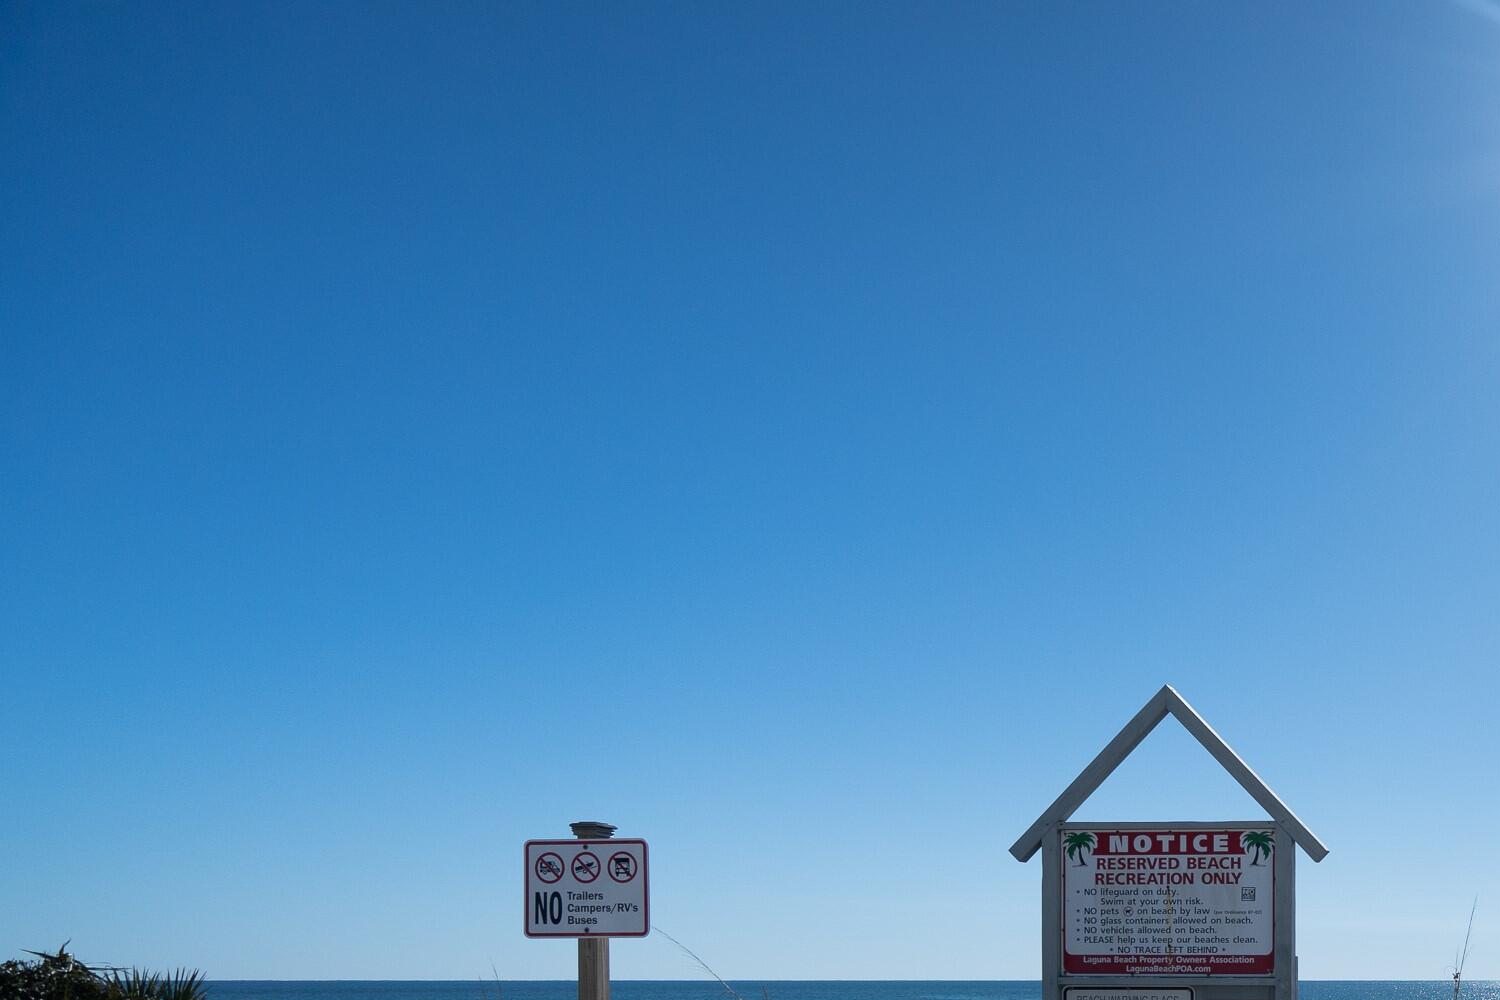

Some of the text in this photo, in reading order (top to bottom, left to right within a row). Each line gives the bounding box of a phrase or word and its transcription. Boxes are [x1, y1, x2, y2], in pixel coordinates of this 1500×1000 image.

[1108, 834, 1230, 853] NOTICE
[1096, 857, 1241, 870] RESERVED BEACH
[1095, 872, 1243, 885] RECREATION ONLY
[567, 891, 604, 900] Trailers
[1083, 888, 1097, 896] NO
[1100, 888, 1139, 897] lifeguard
[1185, 897, 1203, 905] risk.
[535, 891, 563, 925] NO
[567, 903, 639, 914] Campers/RV's
[1083, 907, 1097, 915] NO
[1100, 908, 1119, 916] pets
[1151, 907, 1176, 915] beach
[1180, 907, 1191, 916] by
[1194, 907, 1210, 915] law
[567, 916, 598, 925] Buses
[1083, 917, 1097, 925] NO
[1100, 917, 1122, 926] glass
[1125, 917, 1169, 925] containers
[1173, 916, 1207, 924] allowed
[1225, 916, 1253, 924] beach.
[1100, 926, 1134, 934] vehicles
[1137, 926, 1171, 934] allowed
[1189, 926, 1217, 934] beach.
[1083, 936, 1114, 944] PLEASE
[1117, 936, 1136, 945] help
[1152, 936, 1173, 945] keep
[1117, 946, 1130, 954] NO
[1134, 946, 1161, 954] TRACE
[1083, 956, 1112, 964] Laguna
[1139, 956, 1173, 965] Property
[1126, 965, 1211, 974] LagunaBeachPOA.com
